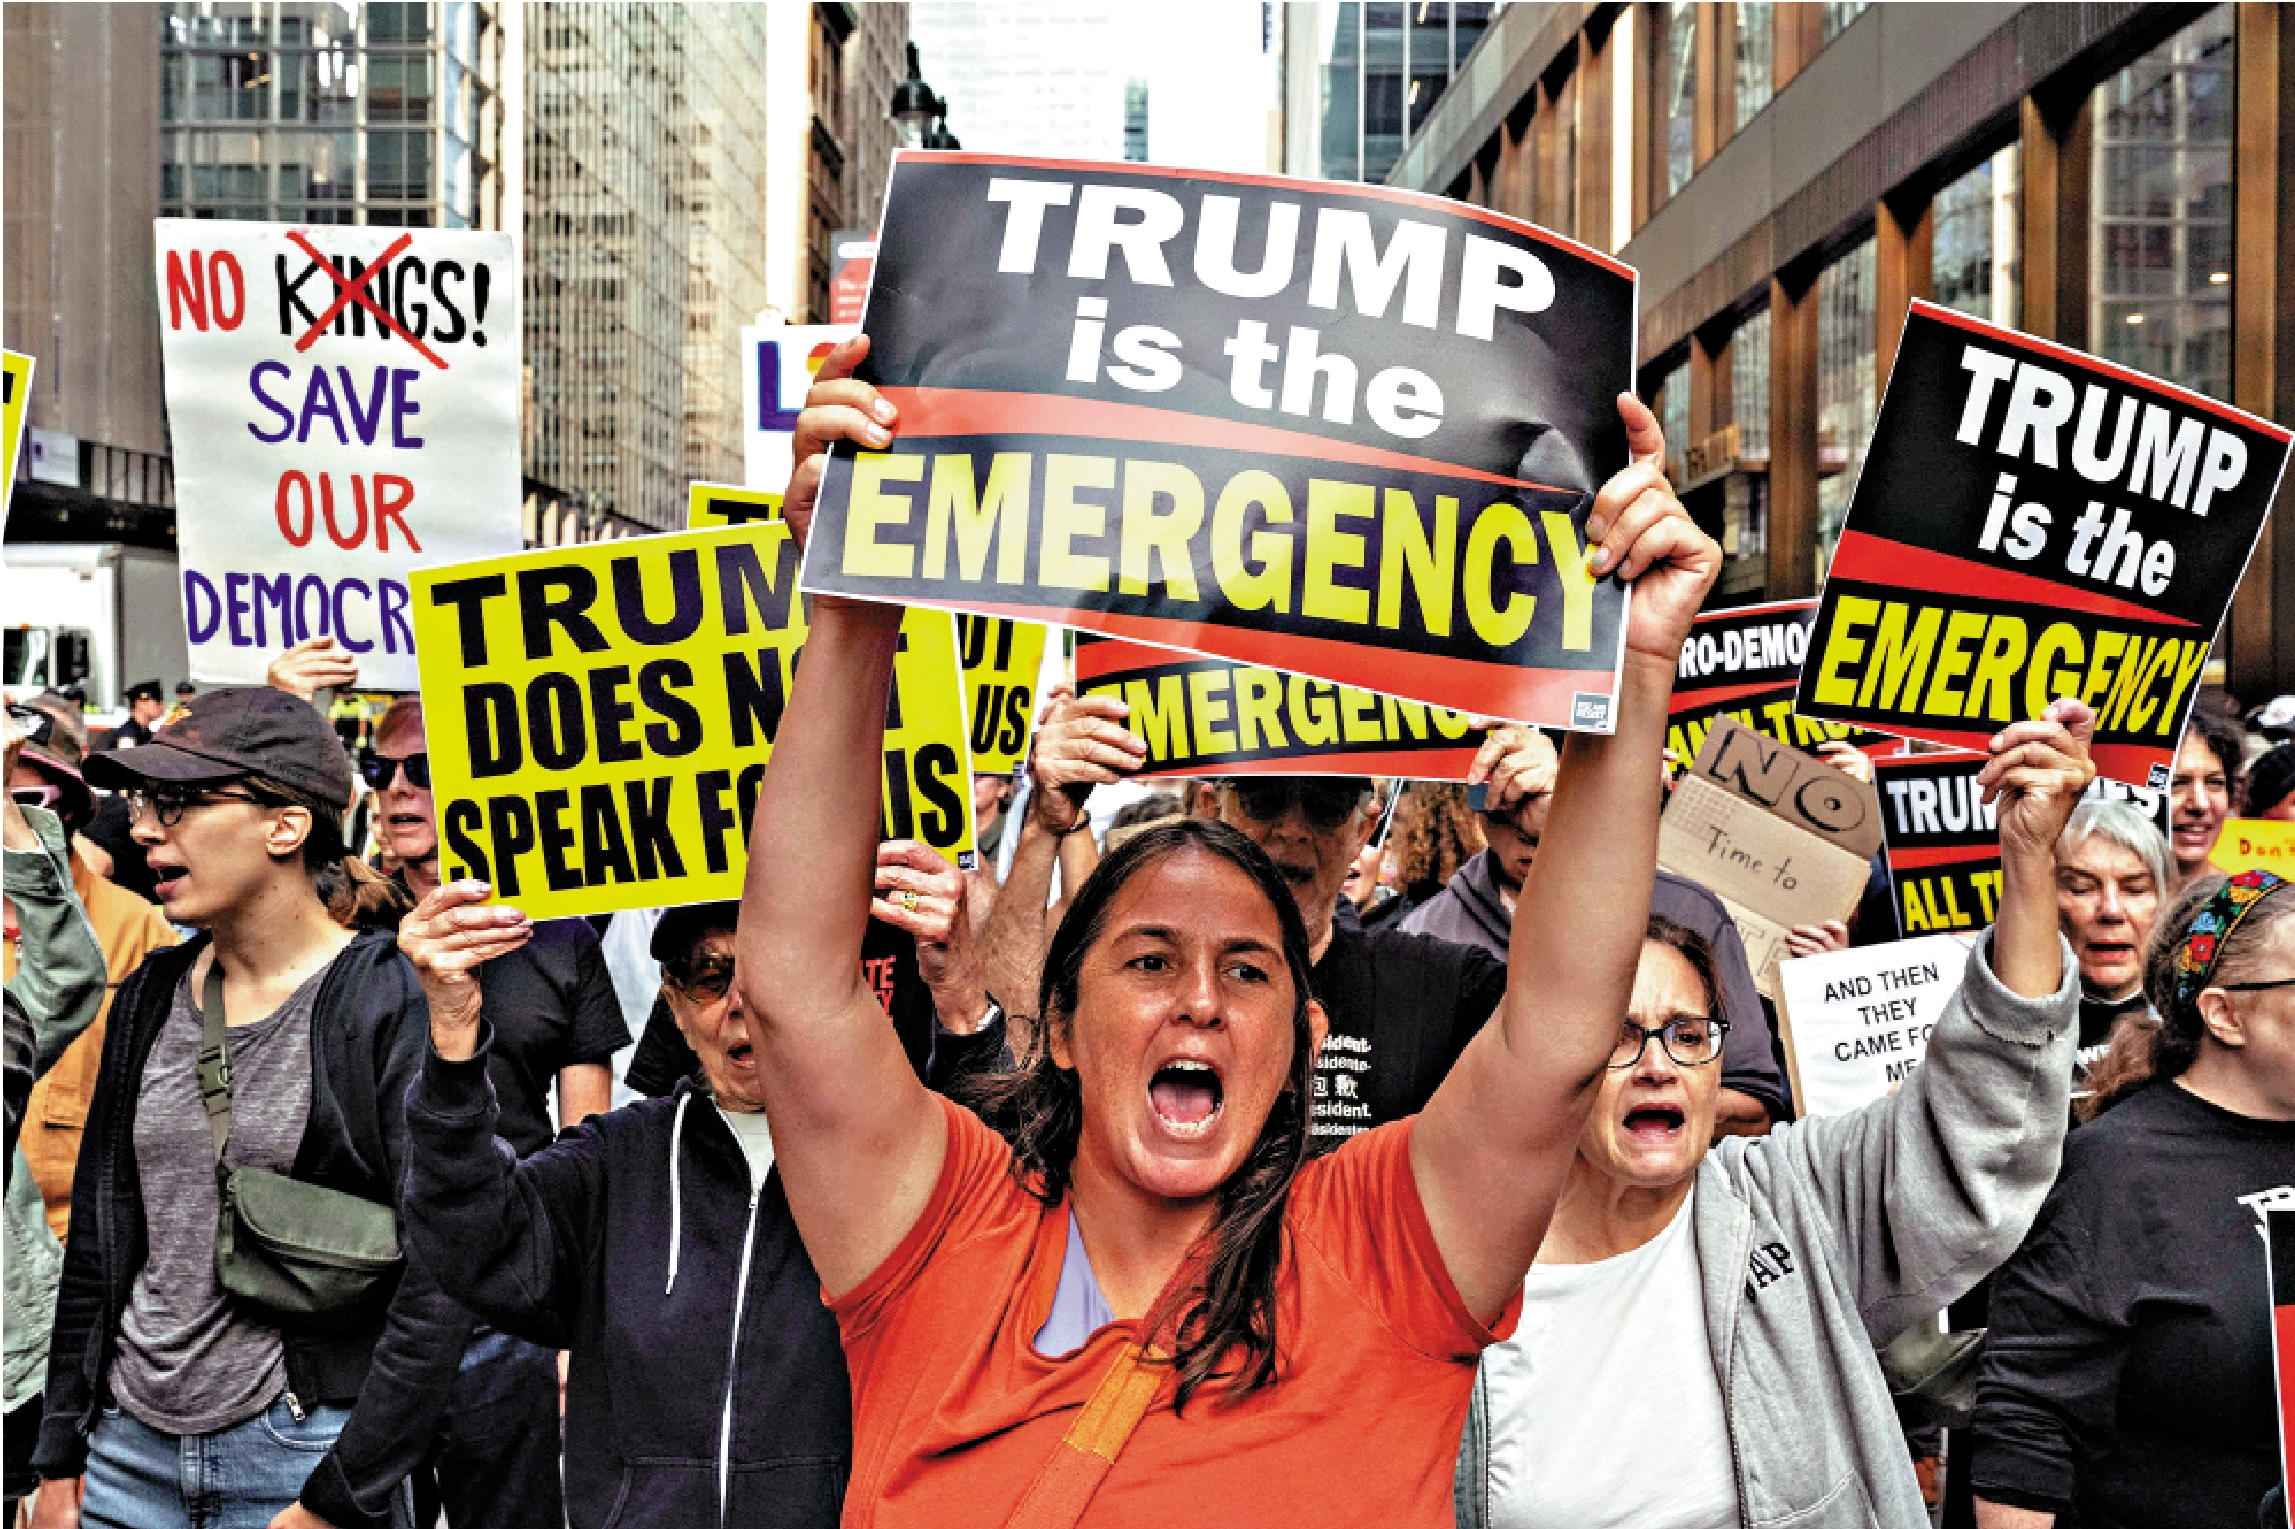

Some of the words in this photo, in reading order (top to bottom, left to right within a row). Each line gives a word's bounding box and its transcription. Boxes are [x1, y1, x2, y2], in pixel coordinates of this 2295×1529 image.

[166, 250, 246, 332] NO
[275, 253, 490, 347] KINGS!
[987, 178, 1556, 341] TRUMP
[248, 359, 425, 449] SAVE
[1065, 296, 1183, 393] is
[1223, 320, 1445, 439] the
[1956, 344, 2248, 516] TRUMP
[275, 469, 422, 554] OUR
[841, 452, 1603, 653] EMERGENCY
[1977, 474, 2053, 561] is
[2067, 507, 2177, 597] the
[1813, 595, 2211, 737] EMERGENCY
[462, 658, 703, 779] DOES
[970, 684, 1030, 755] US
[1709, 728, 1866, 833] NO
[444, 776, 688, 898] SPEAK
[1709, 824, 1762, 872] Time
[1773, 858, 1797, 890] to
[1902, 876, 1972, 932] ALL
[1824, 976, 1872, 1004] AND
[1877, 962, 1940, 991] THEN
[1857, 997, 1917, 1027] THEY
[1834, 1031, 1903, 1062] CAME
